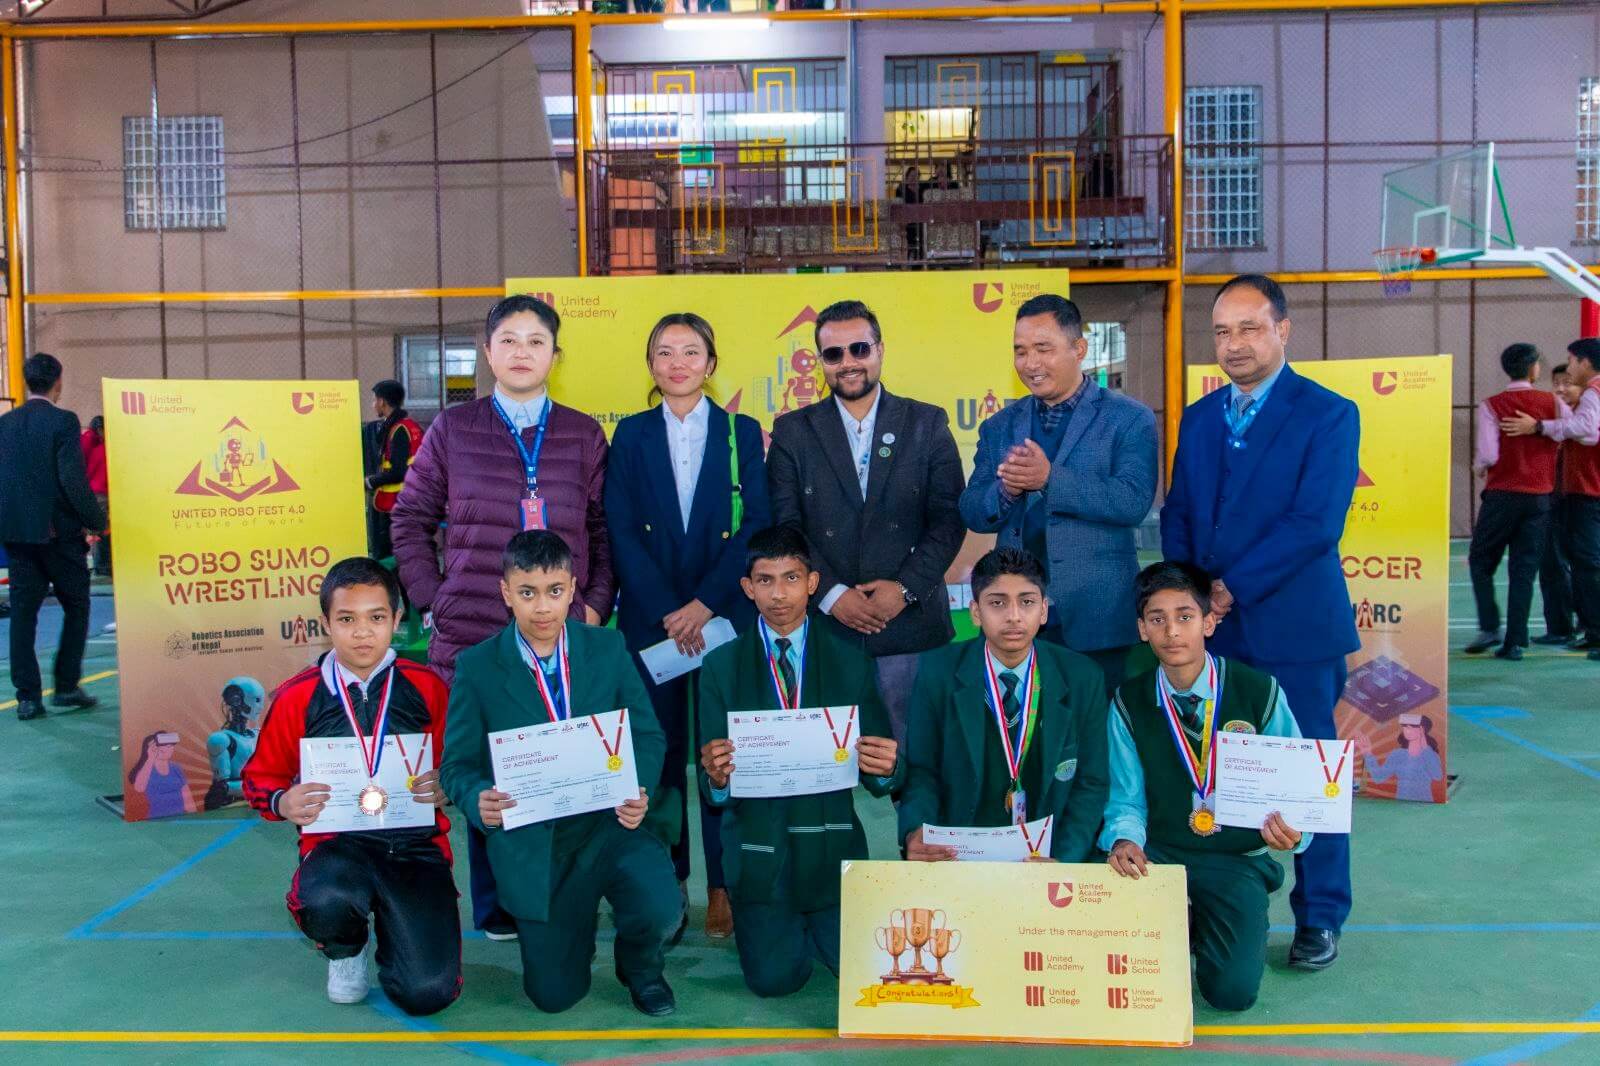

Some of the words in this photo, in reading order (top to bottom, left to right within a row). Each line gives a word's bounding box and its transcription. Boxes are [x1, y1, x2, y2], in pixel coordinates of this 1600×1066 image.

[560, 295, 600, 307] United
[560, 307, 617, 319] Academy
[150, 395, 182, 404] United
[151, 404, 196, 415] Academy
[172, 508, 217, 519] UNITED
[219, 507, 255, 517] ROBO
[258, 505, 286, 515] FEST
[288, 504, 306, 514] 4.0
[1360, 501, 1379, 512] 4.0
[174, 519, 231, 530] Future
[242, 517, 257, 527] of
[269, 516, 304, 526] work
[158, 550, 241, 577] ROBO
[250, 545, 330, 572] SUMO
[165, 573, 325, 606] WRESTLING
[191, 631, 223, 640] Robotics
[223, 627, 264, 638] Association
[192, 641, 200, 651] of
[200, 640, 221, 650] Nepal
[1078, 889, 1112, 898] Academy
[1078, 896, 1102, 904] Group
[1018, 926, 1046, 936] Under
[1050, 927, 1065, 936] the
[1067, 928, 1128, 939] management
[1131, 928, 1142, 938] of
[1143, 930, 1161, 940] uag
[1046, 954, 1073, 963] United
[1130, 957, 1159, 966] United
[1046, 962, 1084, 972] Academy
[1131, 965, 1161, 974] School
[1049, 988, 1076, 996] United
[1049, 996, 1080, 1006] College
[1132, 995, 1163, 1003] Universal
[1132, 1002, 1156, 1010] School
